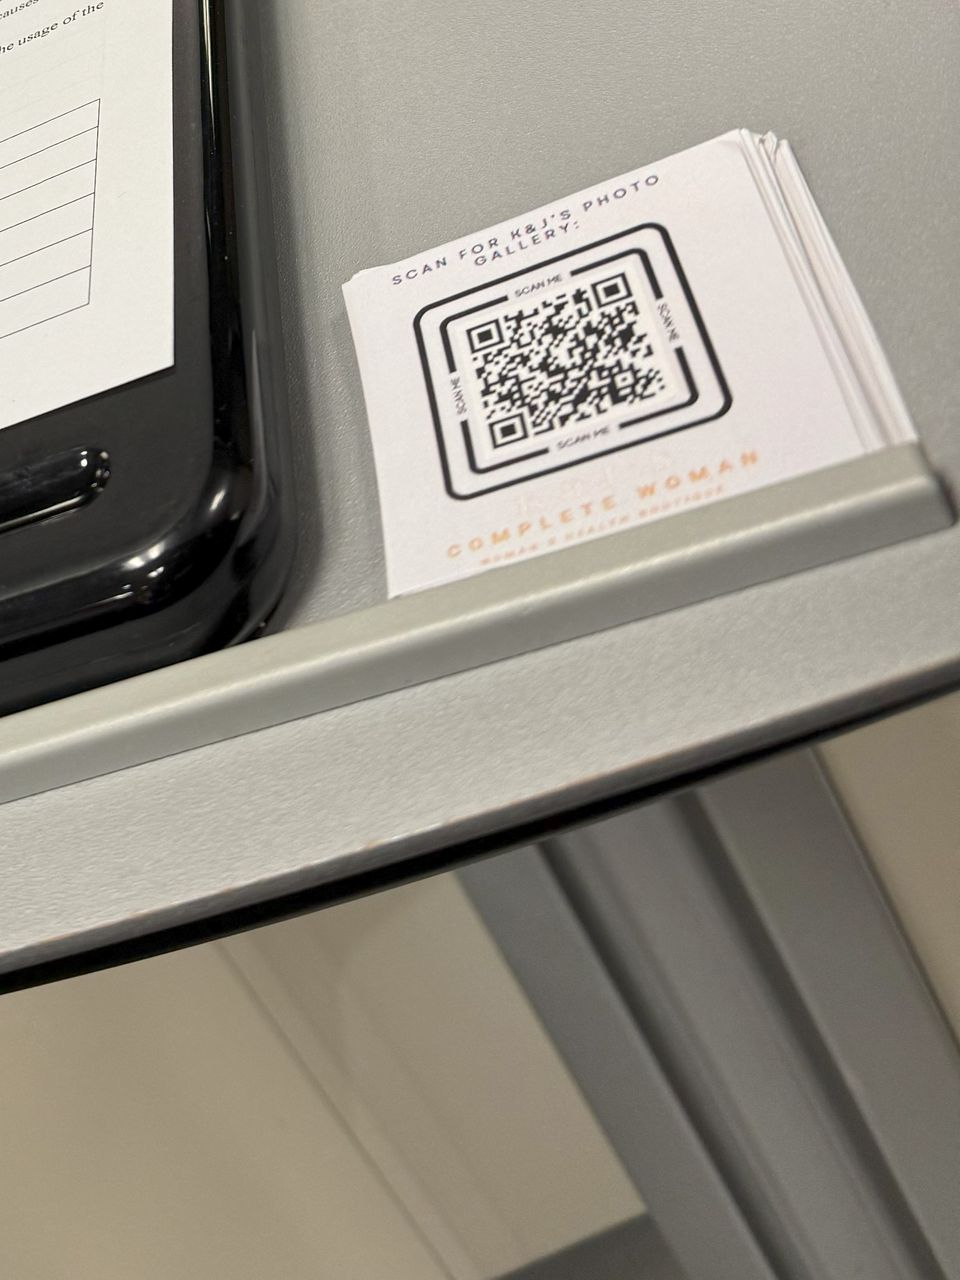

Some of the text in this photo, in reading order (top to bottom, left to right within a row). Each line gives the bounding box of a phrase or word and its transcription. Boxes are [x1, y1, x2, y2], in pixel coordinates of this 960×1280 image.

[17, 20, 58, 49] usage
[61, 8, 79, 26] of
[391, 173, 660, 286] SCAN FOR K&J'S PHOTO
[473, 218, 580, 268] GALLERY:
[513, 273, 562, 298] SCAN ME
[555, 431, 589, 451] SCAN
[445, 493, 617, 559] COMPLETE
[635, 448, 761, 500] WOMAN
